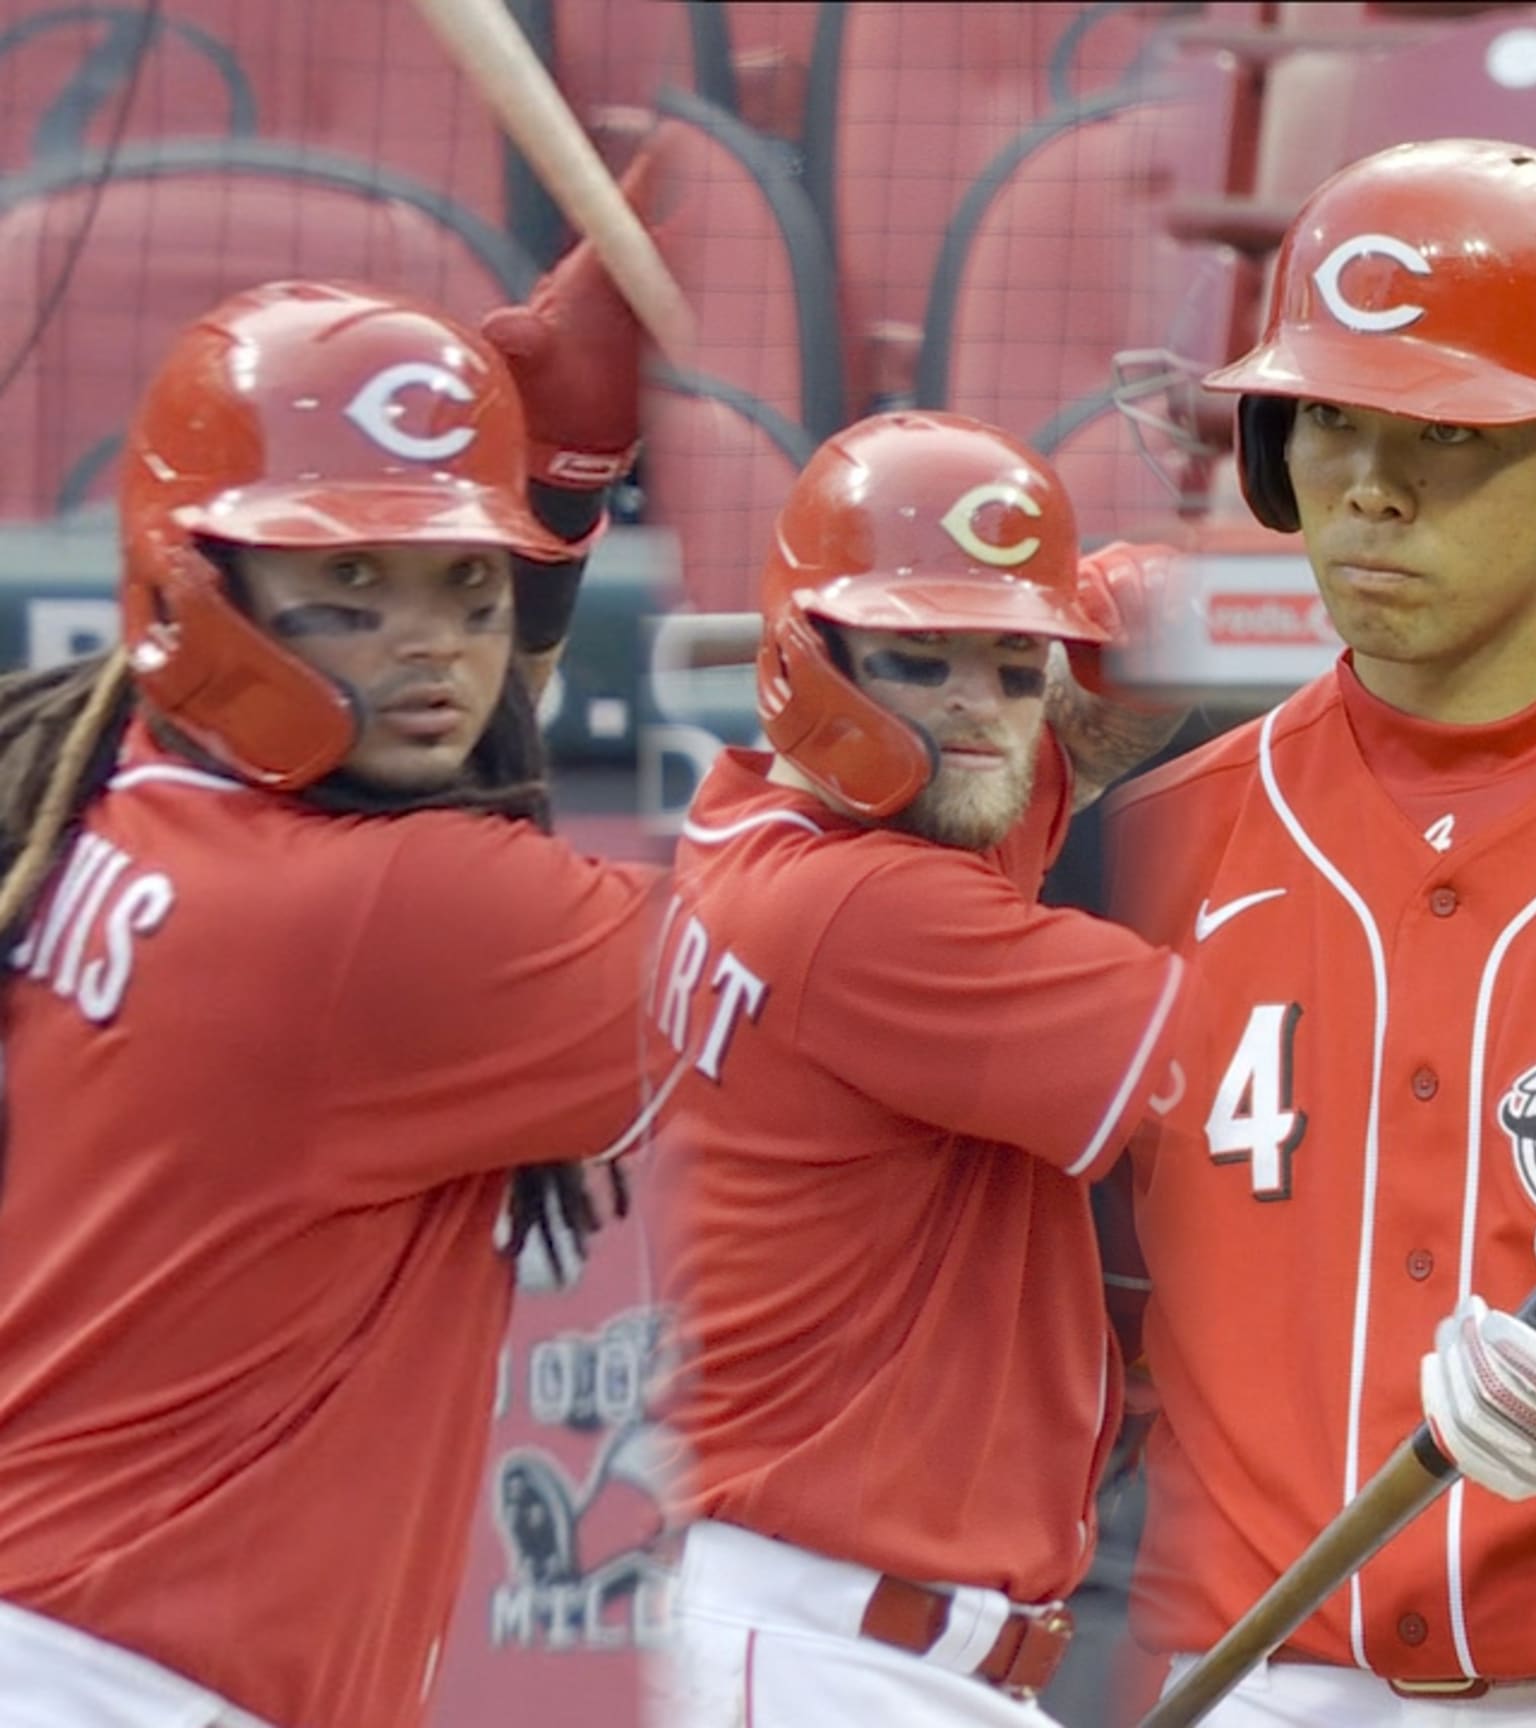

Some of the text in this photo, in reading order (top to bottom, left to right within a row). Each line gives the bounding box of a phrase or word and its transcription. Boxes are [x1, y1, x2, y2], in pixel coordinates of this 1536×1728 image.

[1312, 233, 1434, 332] C
[341, 361, 478, 462] C
[938, 482, 1043, 567] C
[1423, 812, 1456, 854] 4
[10, 831, 175, 1024] VIS
[1203, 1003, 1308, 1203] 4
